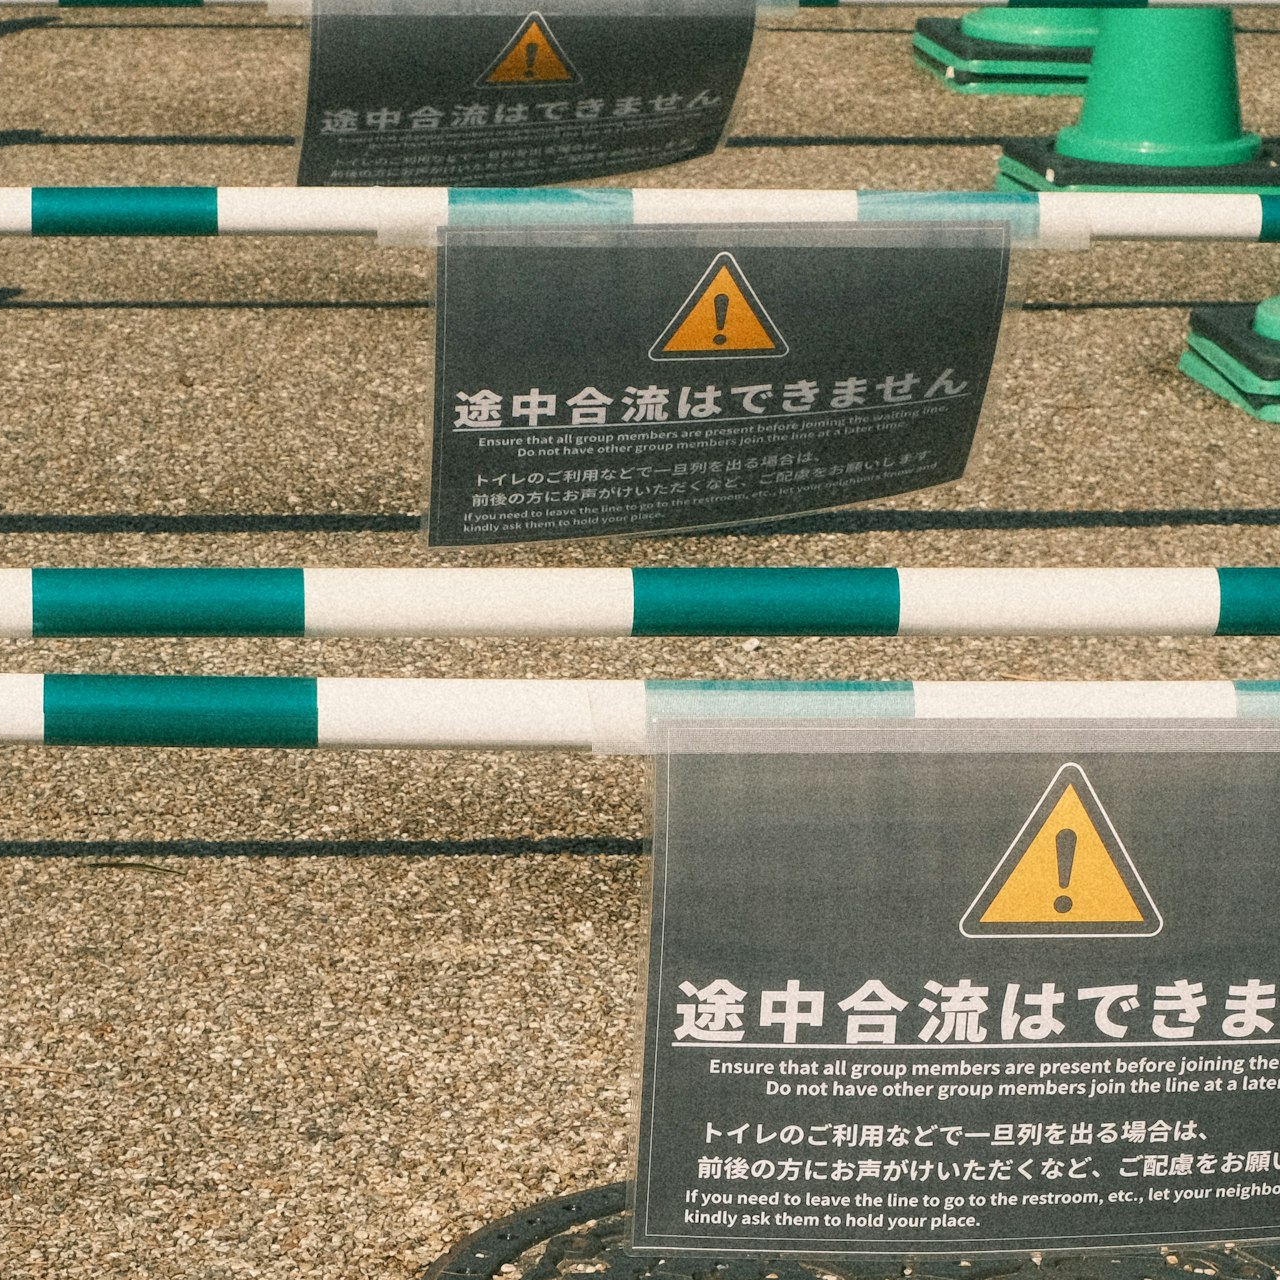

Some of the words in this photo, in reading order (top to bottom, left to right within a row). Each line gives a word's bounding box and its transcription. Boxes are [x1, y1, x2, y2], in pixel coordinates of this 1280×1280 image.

[454, 369, 967, 427] 途中合流はできません
[479, 437, 522, 447] Ensure
[527, 436, 554, 445] that
[556, 434, 572, 444] all
[576, 433, 613, 446] group
[617, 430, 677, 441] members
[705, 428, 754, 437] present
[757, 422, 798, 433] before
[849, 415, 869, 424] the
[517, 448, 538, 457] Do
[542, 447, 560, 456] not
[564, 447, 594, 455] have
[598, 445, 632, 454] other
[636, 443, 673, 453] group
[676, 439, 736, 448] members
[739, 435, 764, 446] join
[767, 433, 788, 441] the
[463, 522, 500, 533] kindly
[502, 522, 521, 530] ask
[525, 520, 555, 529] them
[573, 516, 598, 525] hold
[601, 515, 628, 525] your
[464, 513, 473, 521] If
[475, 512, 496, 522] you
[500, 510, 528, 520] need
[546, 507, 576, 517] leave
[579, 506, 598, 515] the
[601, 505, 622, 513] line
[640, 503, 654, 512] go
[710, 1059, 774, 1074] Ensure
[779, 1059, 819, 1075] that
[823, 1060, 846, 1075] all
[851, 1064, 907, 1079] group
[912, 1060, 1000, 1075] members
[1005, 1063, 1035, 1075] are
[1040, 1060, 1111, 1078] present
[1116, 1057, 1176, 1073] before
[1178, 1056, 1245, 1075] joining
[1249, 1055, 1279, 1070] the
[766, 1080, 791, 1095] Do
[797, 1082, 828, 1096] not
[833, 1081, 878, 1096] have
[883, 1081, 934, 1096] other
[938, 1085, 993, 1100] group
[998, 1080, 1086, 1095] members
[1088, 1079, 1125, 1098] join
[1130, 1078, 1161, 1093] the
[1166, 1077, 1200, 1092] line
[1204, 1078, 1223, 1091] at
[1227, 1080, 1237, 1091] a
[706, 1120, 1207, 1147] トイレのご利用などで一旦列を出る場合は、
[686, 1189, 699, 1203] If
[701, 1193, 732, 1206] you
[738, 1192, 779, 1205] need
[784, 1193, 801, 1205] to
[806, 1192, 850, 1206] leave
[855, 1193, 883, 1207] the
[888, 1193, 918, 1207] line
[922, 1195, 940, 1207] to
[944, 1197, 964, 1210] go
[968, 1194, 986, 1206] to
[990, 1192, 1018, 1206] the
[1022, 1192, 1103, 1205] restroom,
[1108, 1190, 1143, 1204] etc.,
[1149, 1188, 1170, 1201] let
[1173, 1189, 1212, 1203] your
[685, 1209, 737, 1227] kindly
[742, 1212, 770, 1225] ask
[775, 1212, 819, 1226] them
[824, 1214, 841, 1226] to
[846, 1213, 883, 1227] hold
[888, 1217, 927, 1230] your
[931, 1214, 980, 1230] place.
